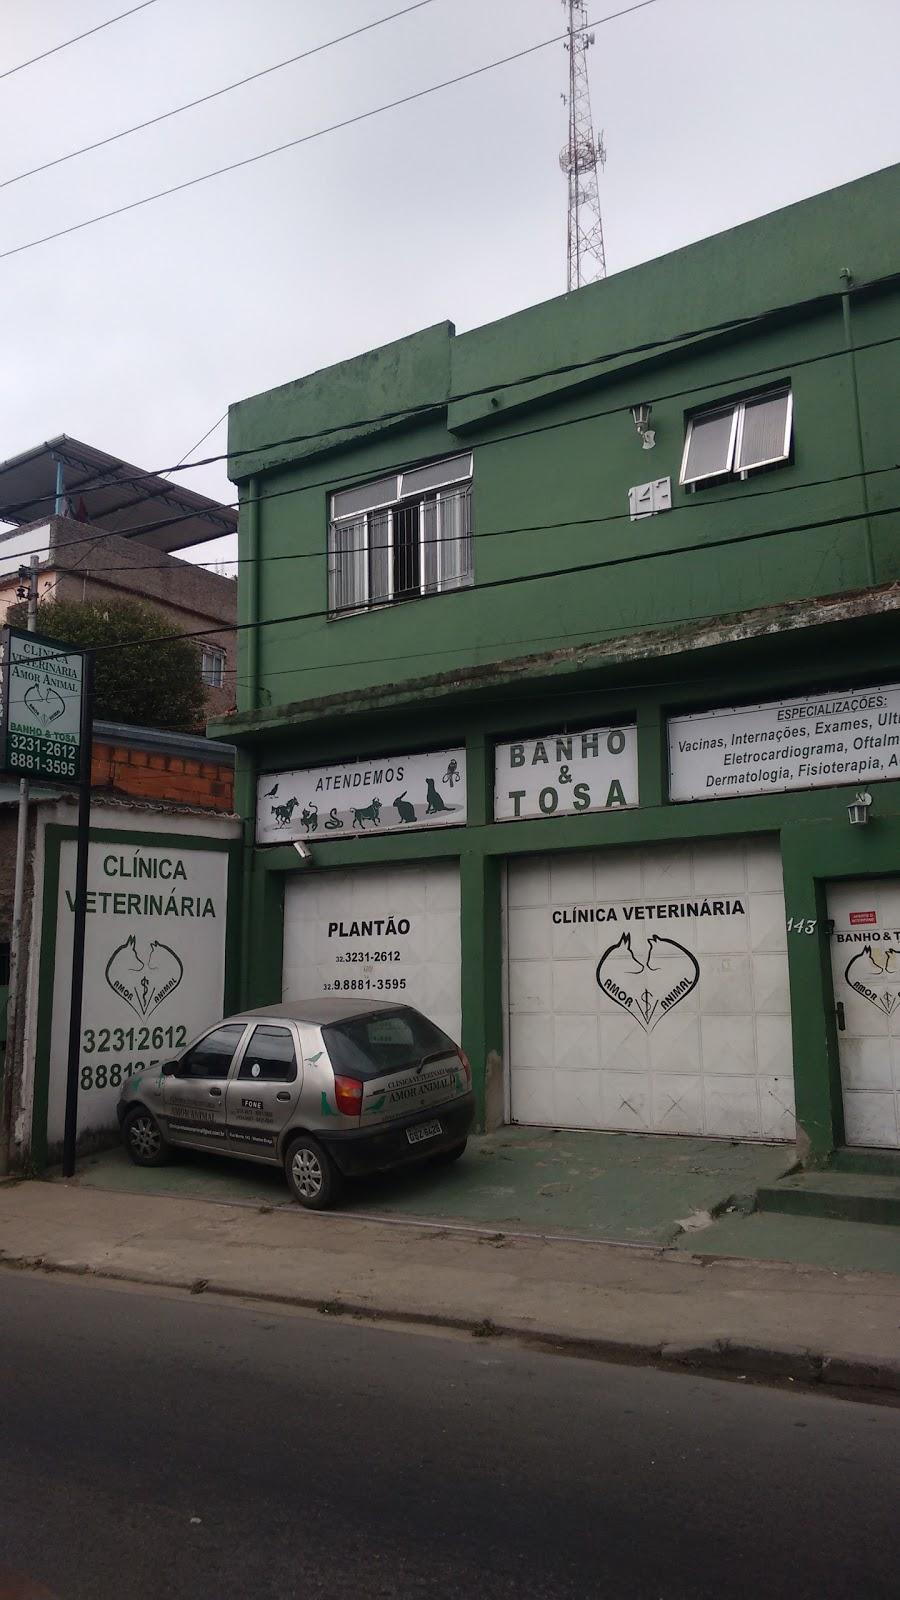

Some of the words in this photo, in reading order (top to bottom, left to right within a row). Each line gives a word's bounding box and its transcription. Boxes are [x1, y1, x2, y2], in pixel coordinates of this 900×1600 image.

[777, 695, 888, 721] ESPECIALIZAÇÕES:
[10, 722, 42, 736] BANHO
[45, 729, 52, 738] &
[53, 731, 77, 743] TOSA
[678, 737, 727, 753] Vacinas,
[731, 726, 810, 746] Internações,
[815, 718, 872, 735] Exames,
[11, 734, 76, 759] 3231-2612
[510, 730, 626, 768] BANHO
[723, 742, 848, 766] Eletrocardiograma,
[10, 752, 75, 776] 8881-3595
[558, 765, 572, 784] &
[706, 766, 793, 787] Dermatologia,
[798, 756, 884, 777] Fisioterapia,
[315, 766, 405, 792] ATENDEMOS
[509, 779, 627, 816] TOSA
[103, 849, 187, 880] CLÍNICA
[65, 887, 216, 918] VETERINÁRIA
[552, 907, 618, 924] CLÍNICA
[622, 898, 745, 921] VETERINÁRIA
[328, 915, 410, 937] PLANTÃO
[786, 917, 817, 934] 143
[837, 932, 881, 943] BANHO
[883, 931, 892, 941] &
[113, 980, 134, 1002] AMOR
[154, 977, 178, 1004] ANIMAL
[604, 978, 633, 1007] AMOR
[660, 977, 693, 1010] ANIMAL
[853, 981, 878, 1001] AMOR
[244, 1100, 262, 1109] FONE
